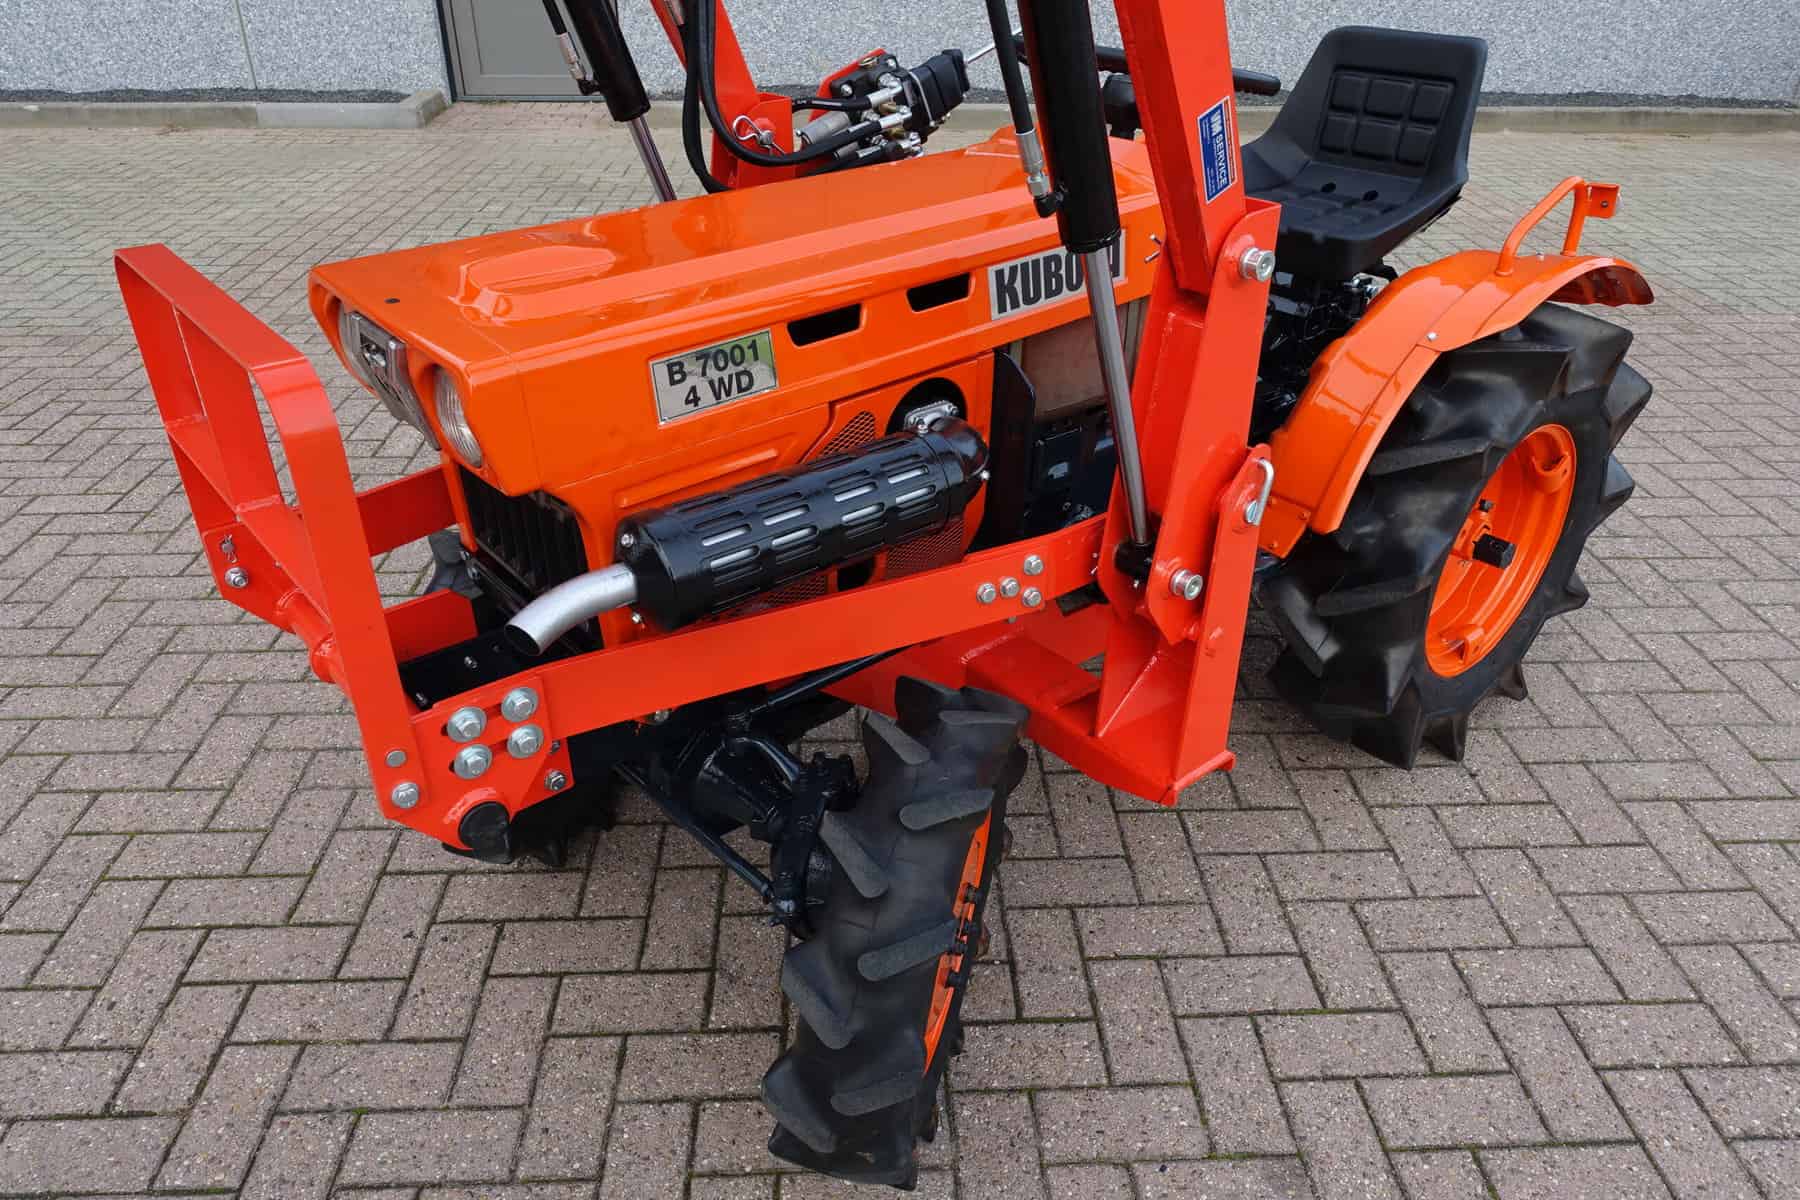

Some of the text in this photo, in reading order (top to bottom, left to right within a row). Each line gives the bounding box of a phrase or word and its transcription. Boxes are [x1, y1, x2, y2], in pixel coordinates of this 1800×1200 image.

[1216, 134, 1228, 186] SERVICE
[995, 235, 1121, 314] KUBO
[667, 339, 759, 386] B 7001
[684, 369, 754, 407] 4 WD
